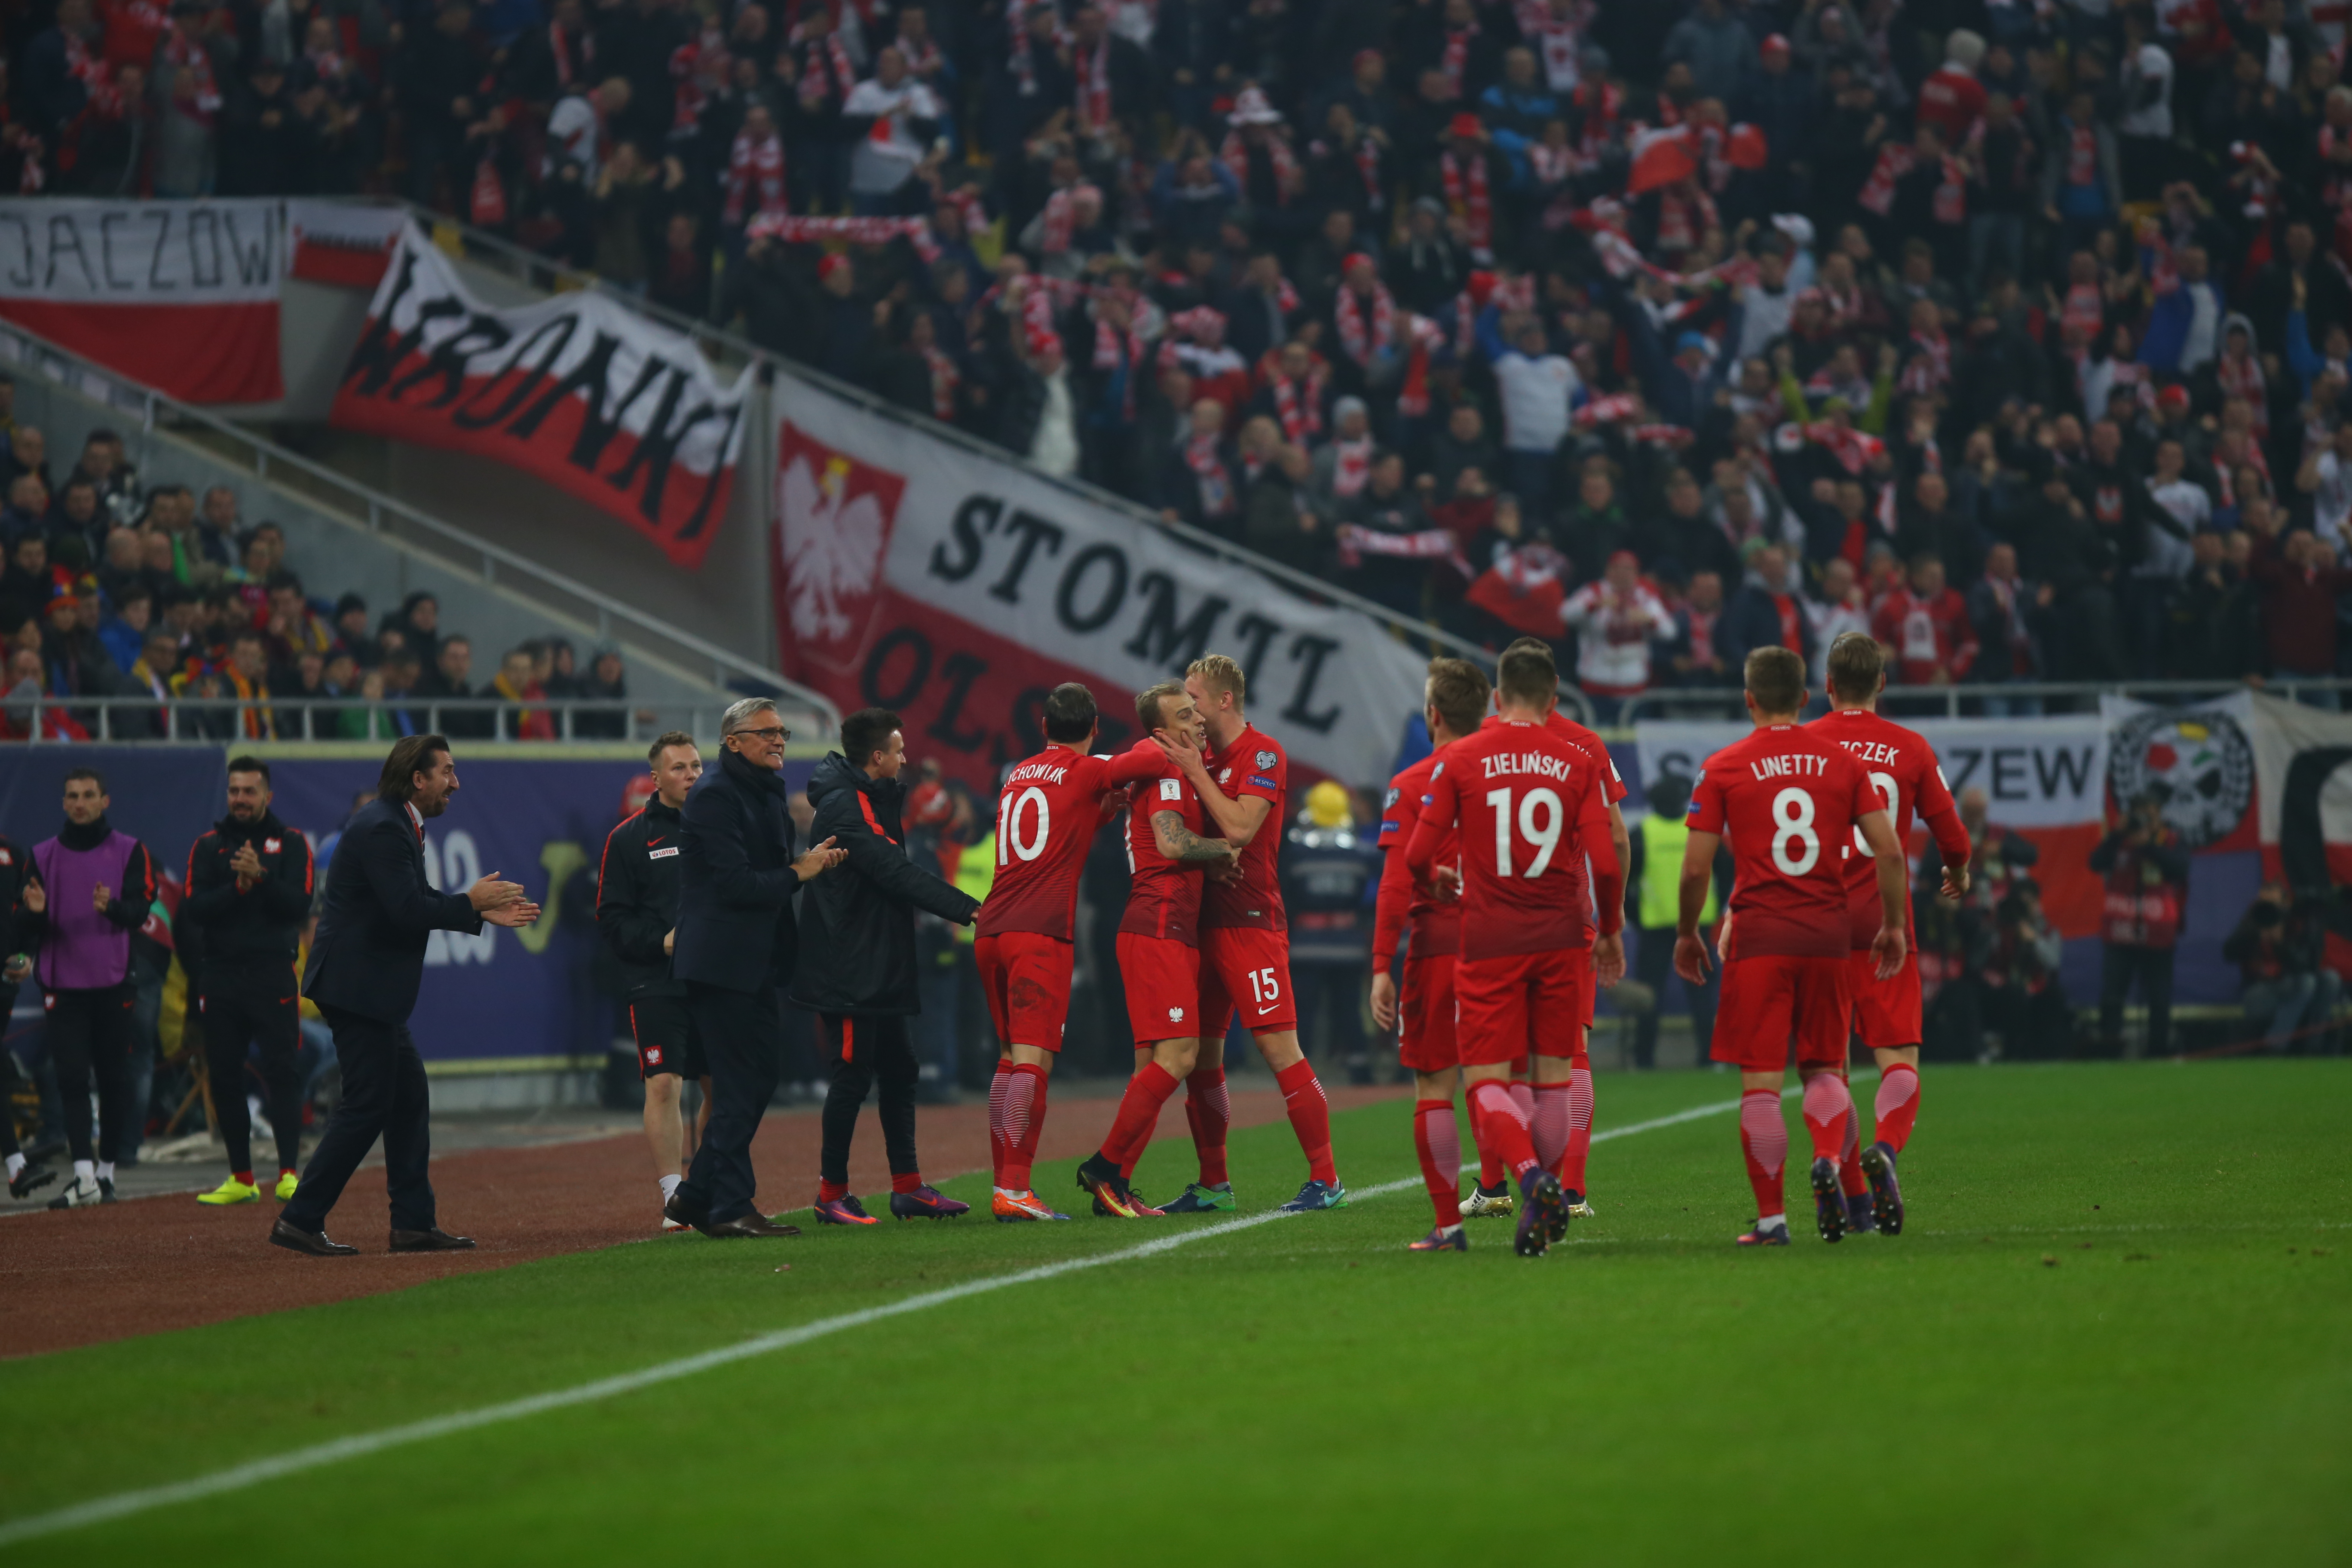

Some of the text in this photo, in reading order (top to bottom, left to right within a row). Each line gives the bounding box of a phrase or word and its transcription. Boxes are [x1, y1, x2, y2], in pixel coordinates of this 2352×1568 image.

[928, 492, 1342, 733] STOMIL
[1001, 763, 1068, 791] YCHOWIAK
[1255, 778, 1275, 787] RESPECT
[1481, 750, 1571, 783] ZIELIŃSKI
[1750, 753, 1828, 782] LINETTY
[998, 786, 1050, 866] 10
[1486, 786, 1564, 879] 19
[1771, 787, 1820, 876] 8
[1247, 967, 1279, 1002] 15
